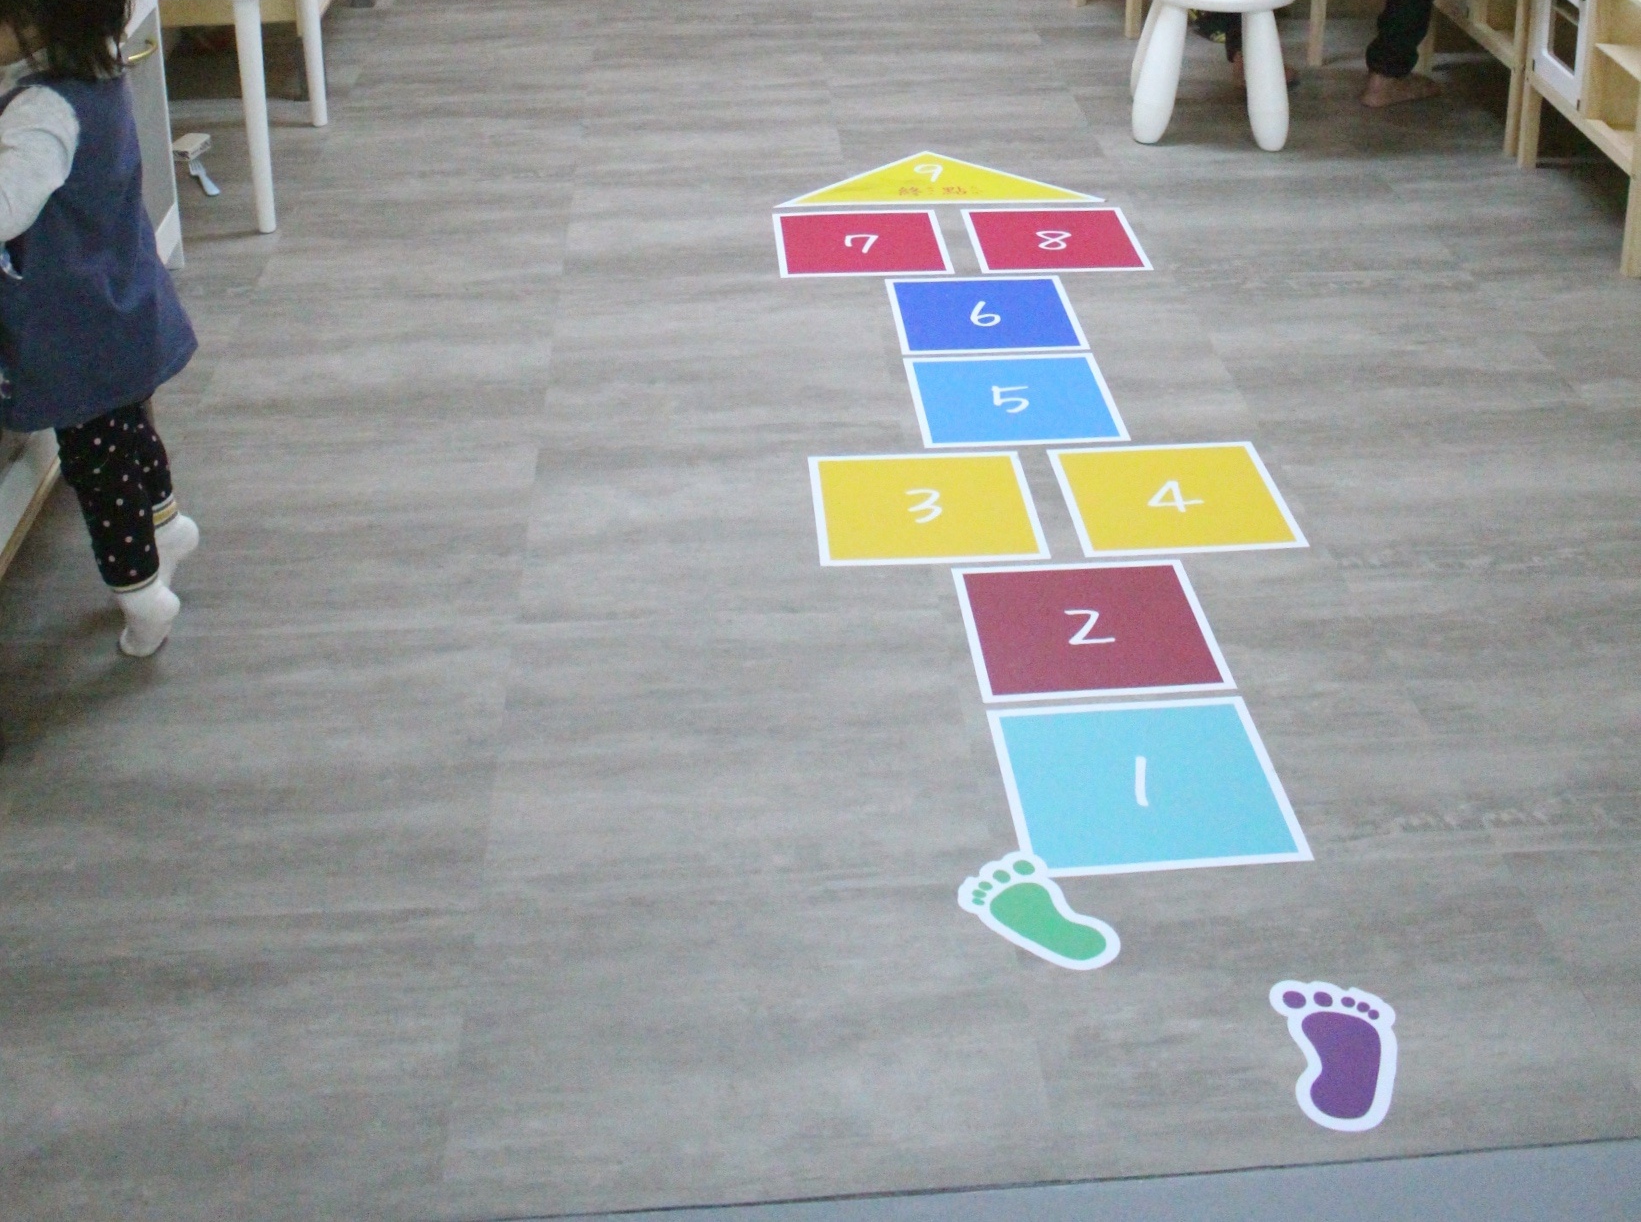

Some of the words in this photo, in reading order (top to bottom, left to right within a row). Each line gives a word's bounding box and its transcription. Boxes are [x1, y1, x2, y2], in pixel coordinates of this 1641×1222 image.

[913, 163, 944, 183] 9
[843, 232, 880, 256] 7
[1035, 229, 1073, 252] 8
[970, 300, 1001, 328] 6
[990, 384, 1030, 415] 5
[906, 487, 944, 524] 3
[1147, 479, 1205, 514] 4
[1063, 608, 1116, 646] 2
[1134, 755, 1149, 808] 1
